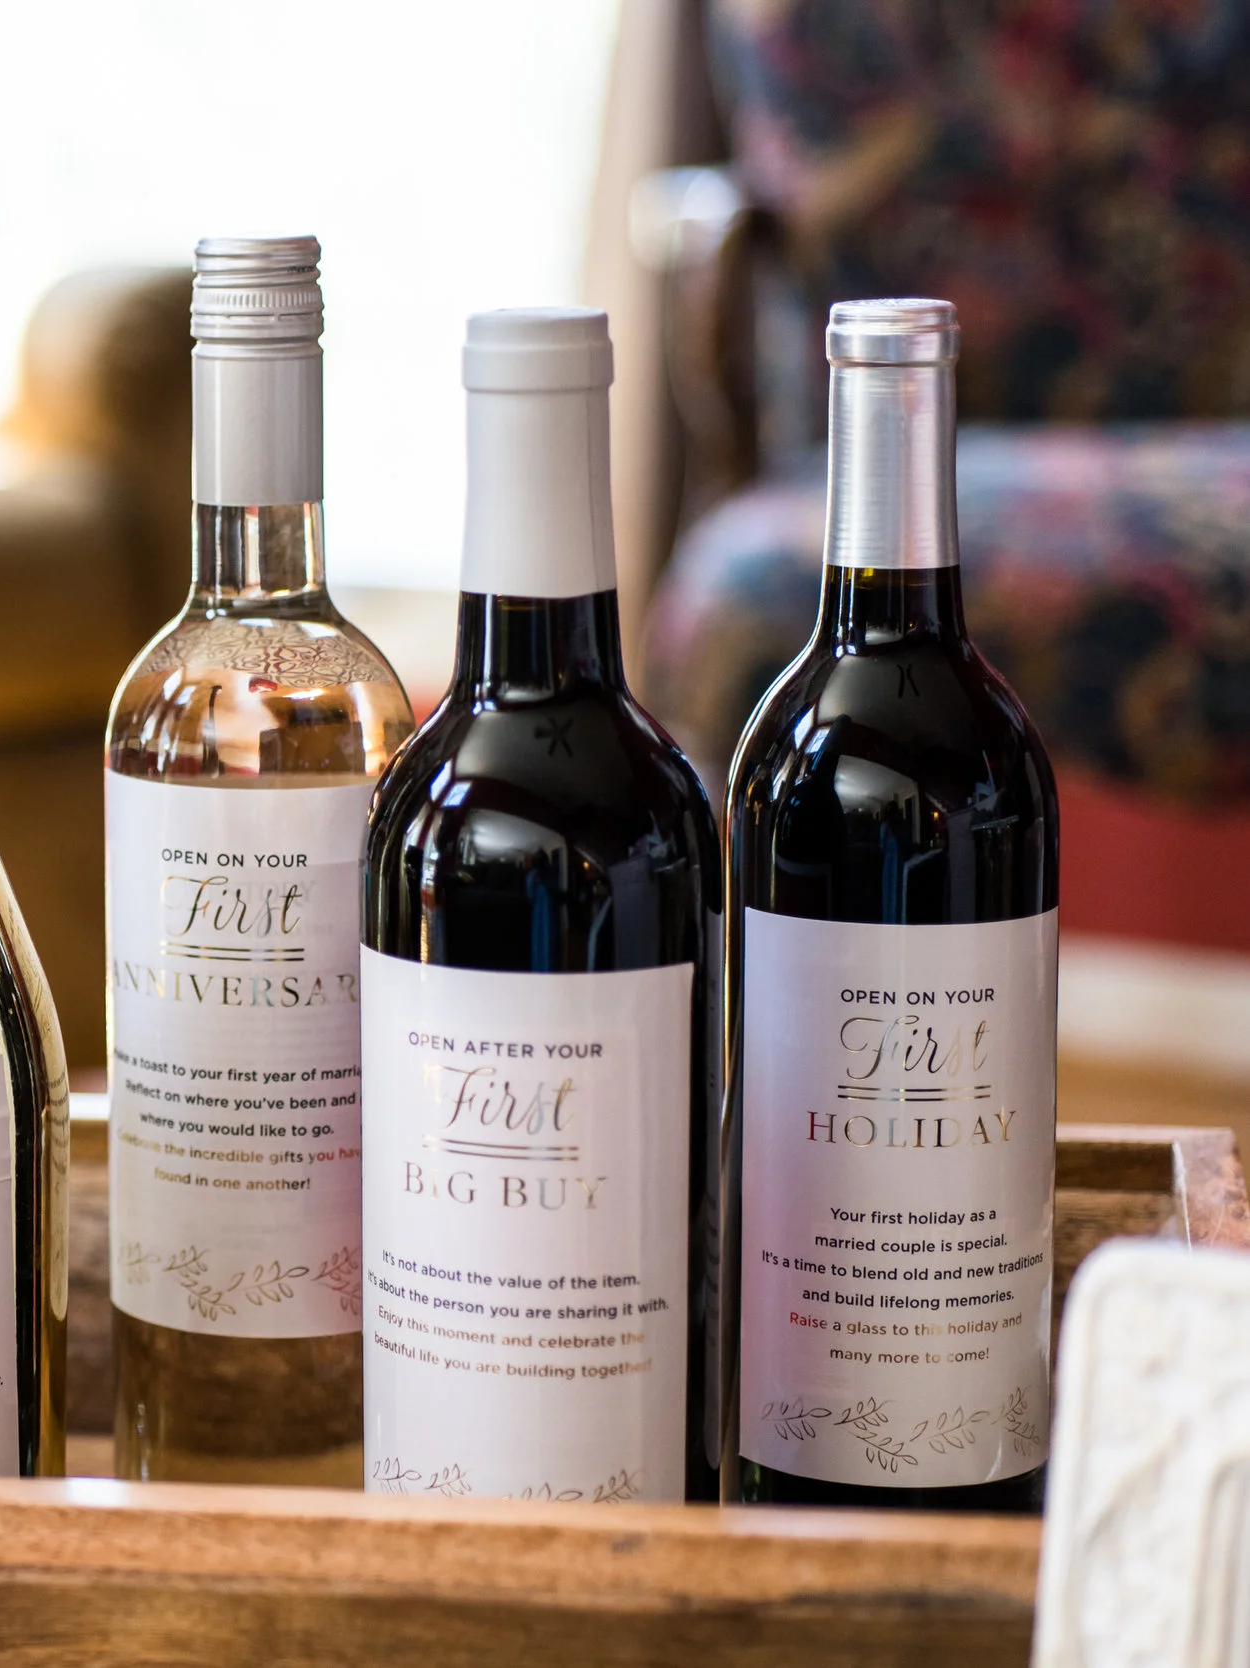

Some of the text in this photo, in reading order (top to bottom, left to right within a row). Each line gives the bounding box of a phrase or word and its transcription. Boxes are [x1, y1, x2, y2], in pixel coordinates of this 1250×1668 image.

[161, 849, 307, 868] OPEN ON YOUR
[160, 876, 302, 937] First
[113, 957, 357, 1008] ANNIVERSAR
[840, 988, 995, 1006] OPEN ON YOUR
[408, 1032, 603, 1059] OPEN AFTER YOUR
[840, 1015, 990, 1080] First
[140, 1058, 361, 1085] toast to your first year of marria
[164, 1091, 356, 1111] on where you've been and
[423, 1063, 577, 1135] First
[139, 1112, 335, 1138] where you would like to go.
[806, 1109, 1017, 1148] HOLIDAY
[164, 1142, 360, 1166] the incredible gifts you hav
[154, 1167, 311, 1191] found one another!
[403, 1160, 608, 1211] BIG BUY
[830, 1207, 985, 1226] Your first holiday as
[814, 1234, 1008, 1255] married couple is special.
[398, 1258, 641, 1290] not about the value of the item.
[761, 1249, 1044, 1281] It's time to blend old and new traditions
[379, 1279, 670, 1321] about the person you are sharing with.
[802, 1288, 1015, 1310] and build lifelong memories.
[378, 1304, 645, 1349] Enjoy this moment and celebrate the
[789, 1311, 1023, 1337] Raise glass to holiday and
[374, 1330, 416, 1360] beautiful
[419, 1348, 440, 1366] life
[444, 1356, 471, 1372] you
[475, 1361, 501, 1375] are
[506, 1362, 576, 1380] building
[829, 1347, 990, 1364] many more to come!
